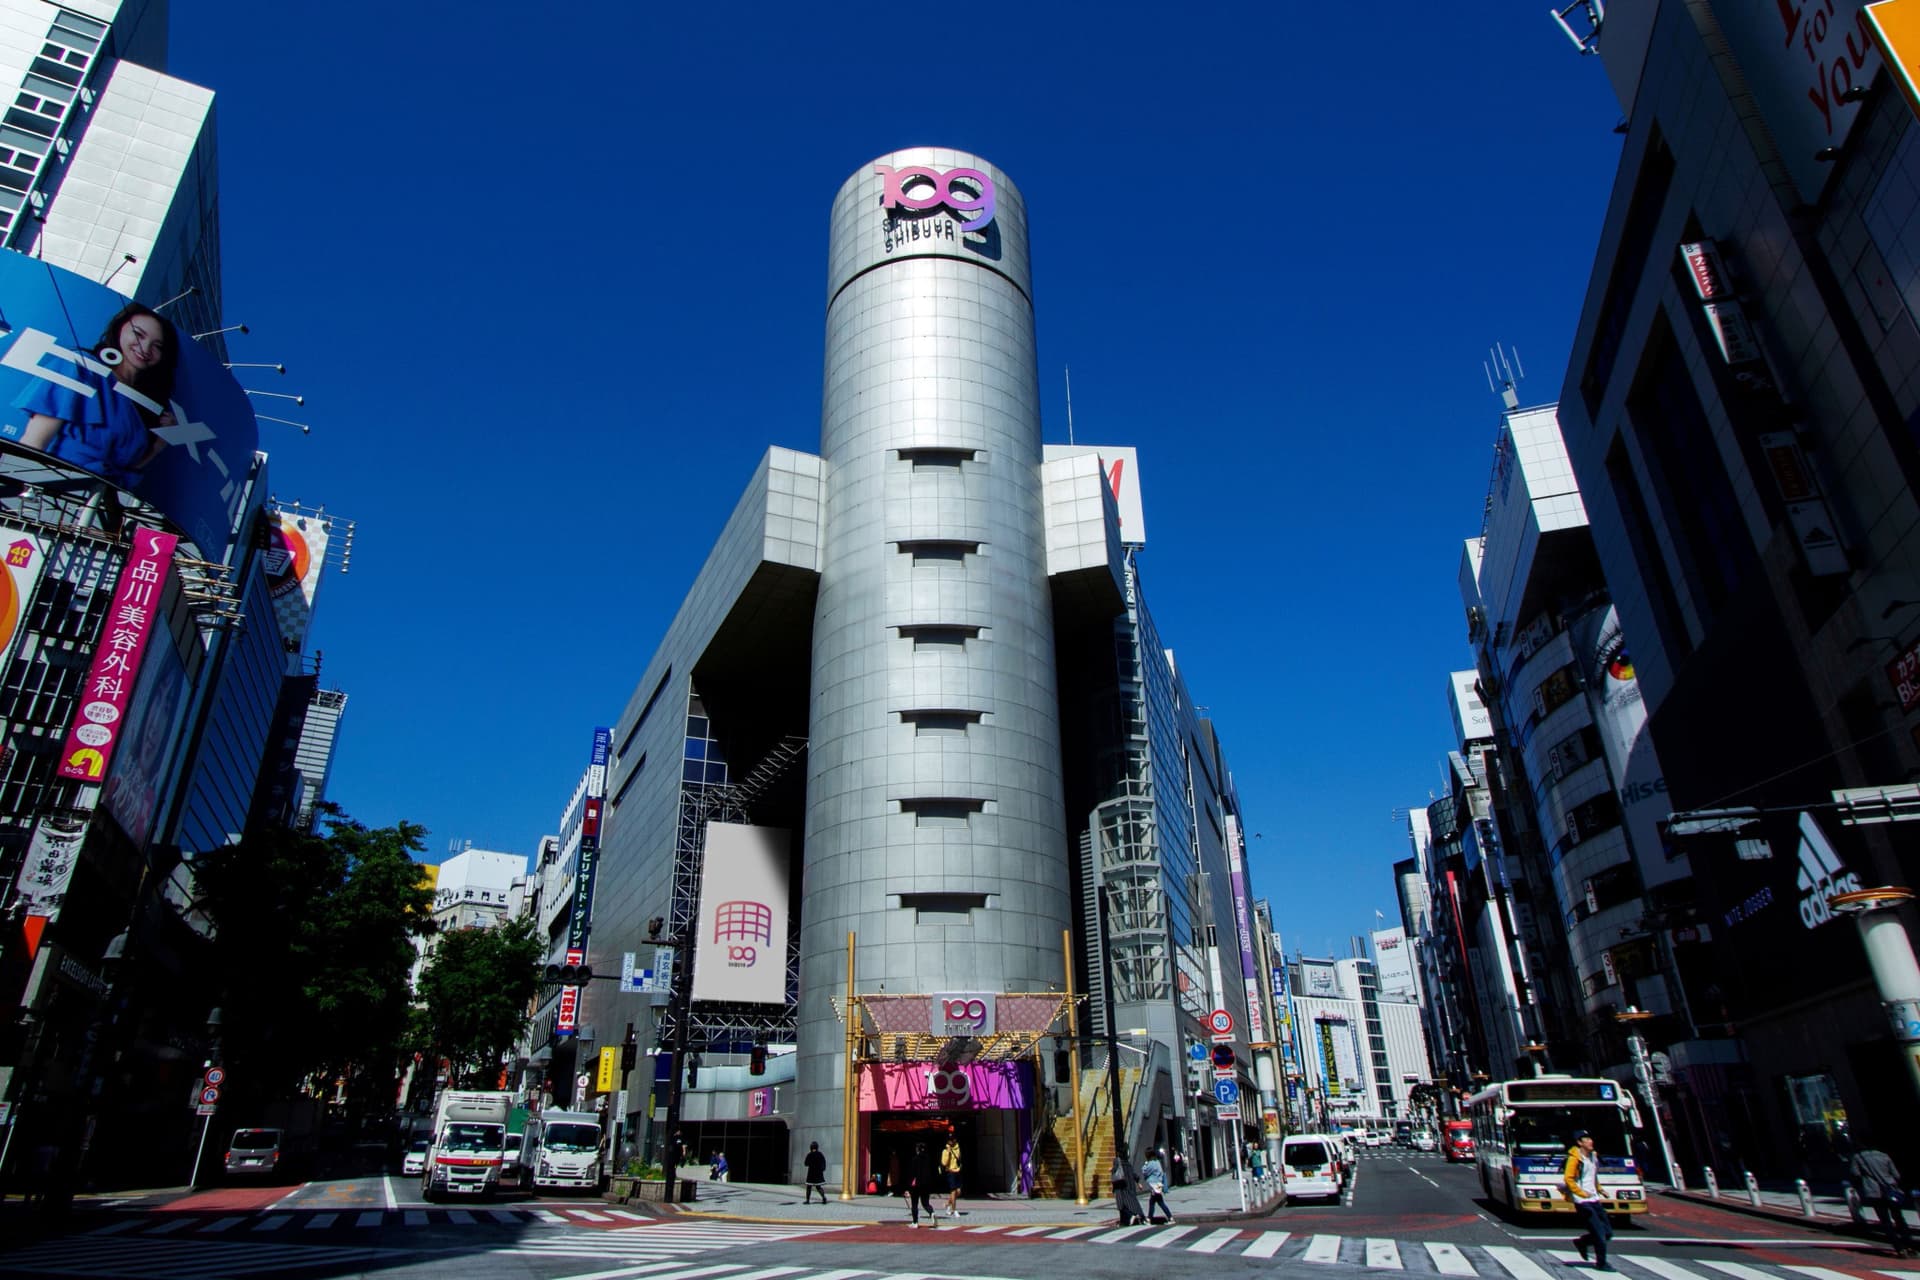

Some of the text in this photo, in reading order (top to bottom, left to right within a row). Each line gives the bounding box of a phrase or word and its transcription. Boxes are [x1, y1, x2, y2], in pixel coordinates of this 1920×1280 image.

[874, 165, 996, 233] 109
[92, 559, 160, 701] 品川美容外科
[728, 945, 756, 968] 109
[560, 956, 580, 1023] HTERS
[942, 998, 987, 1030] 109
[1215, 1016, 1227, 1028] 30
[924, 1070, 971, 1106] 109
[1219, 1085, 1230, 1103] P
